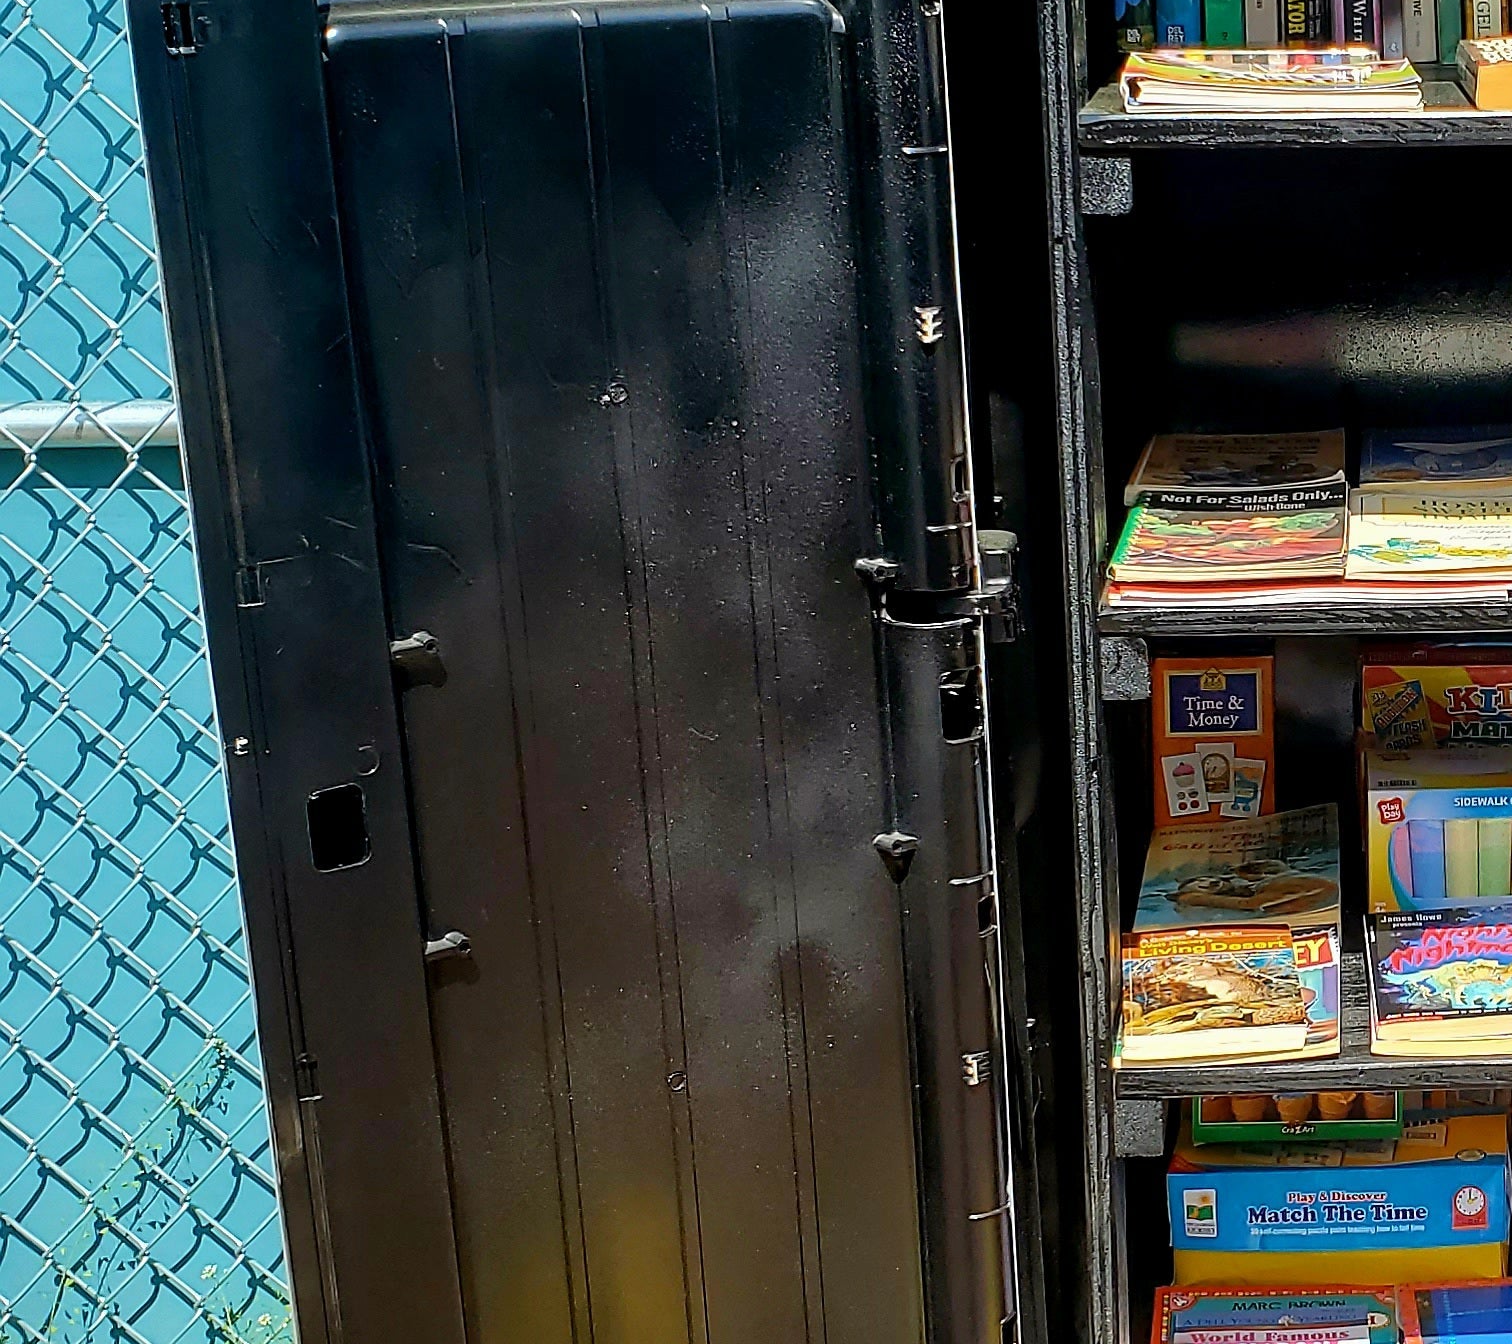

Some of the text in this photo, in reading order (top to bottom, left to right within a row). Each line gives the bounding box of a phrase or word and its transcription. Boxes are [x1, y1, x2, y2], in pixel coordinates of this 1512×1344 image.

[1352, 1, 1366, 43] WHIT
[1161, 490, 1343, 505] Not For Salads Only...
[1183, 695, 1244, 711] Time &
[1187, 713, 1239, 728] Money
[1454, 796, 1508, 807] SIDEWALK
[1247, 1202, 1428, 1225] Match The Time
